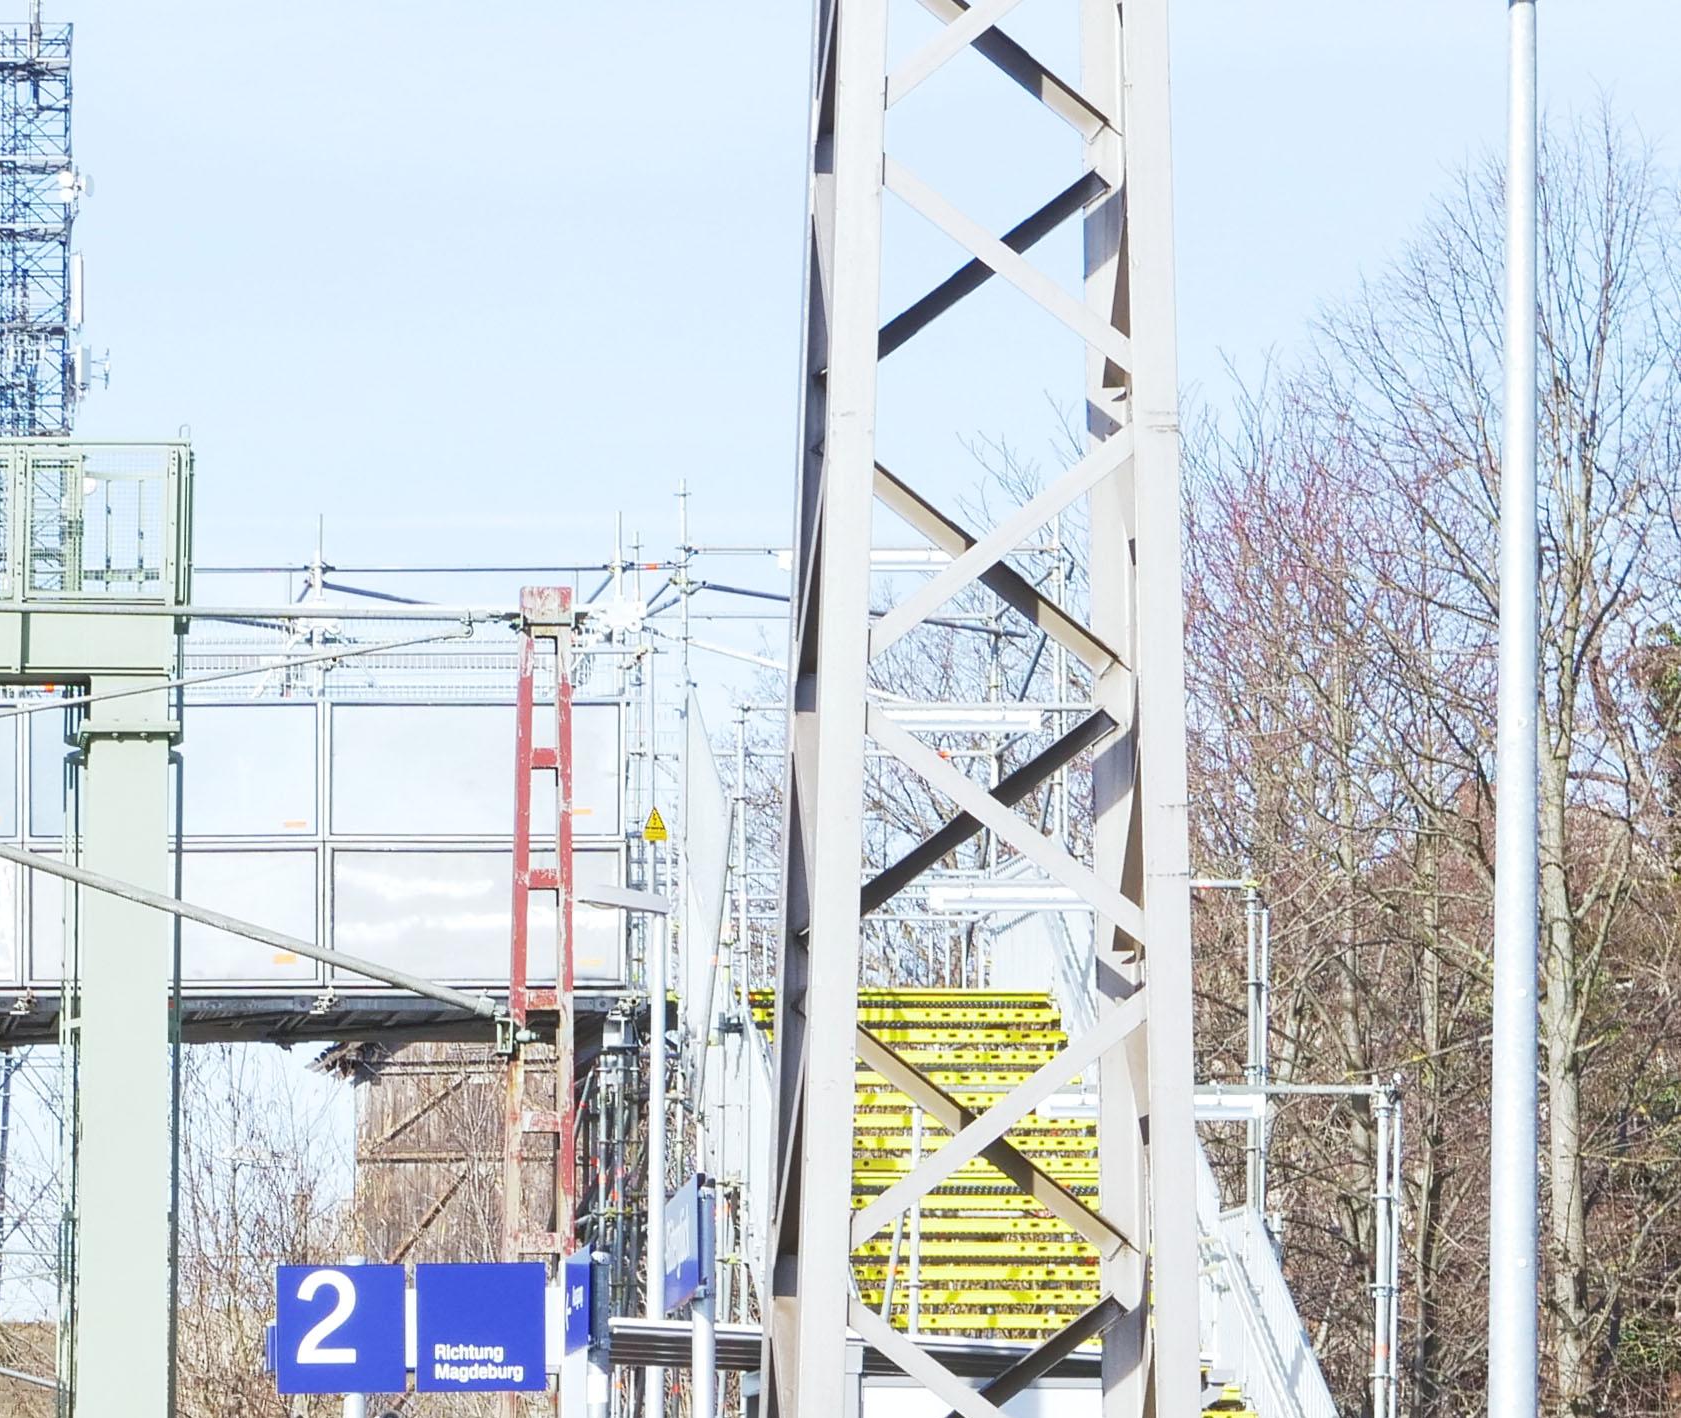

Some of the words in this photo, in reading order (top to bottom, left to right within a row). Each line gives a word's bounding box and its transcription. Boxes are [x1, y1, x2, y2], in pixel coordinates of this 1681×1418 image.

[295, 1269, 357, 1364] 2
[434, 1344, 504, 1364] Richtung
[434, 1364, 524, 1383] Magdeburg
